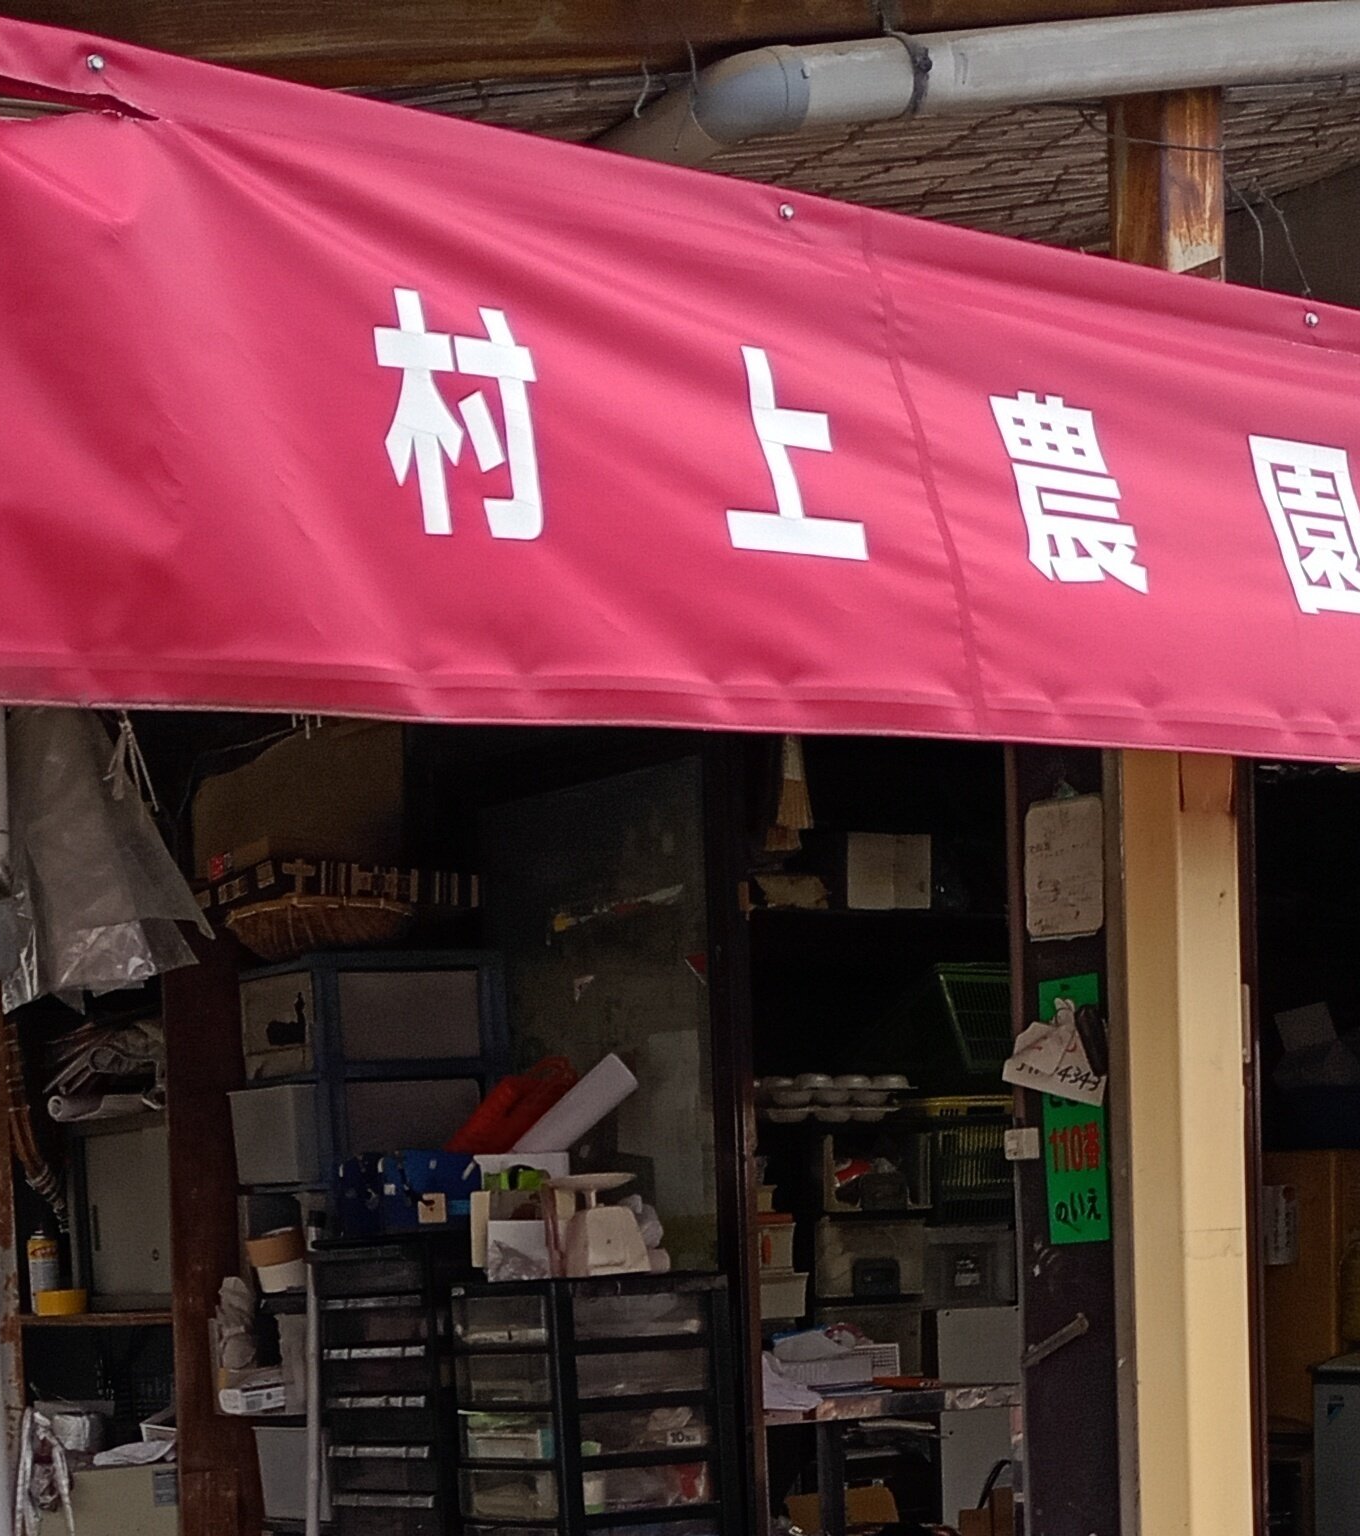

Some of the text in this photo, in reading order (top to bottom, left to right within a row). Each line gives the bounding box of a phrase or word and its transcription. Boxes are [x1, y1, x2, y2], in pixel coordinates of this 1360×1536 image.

[1049, 1122, 1101, 1173] 110番
[1055, 1188, 1102, 1232] のいえ
